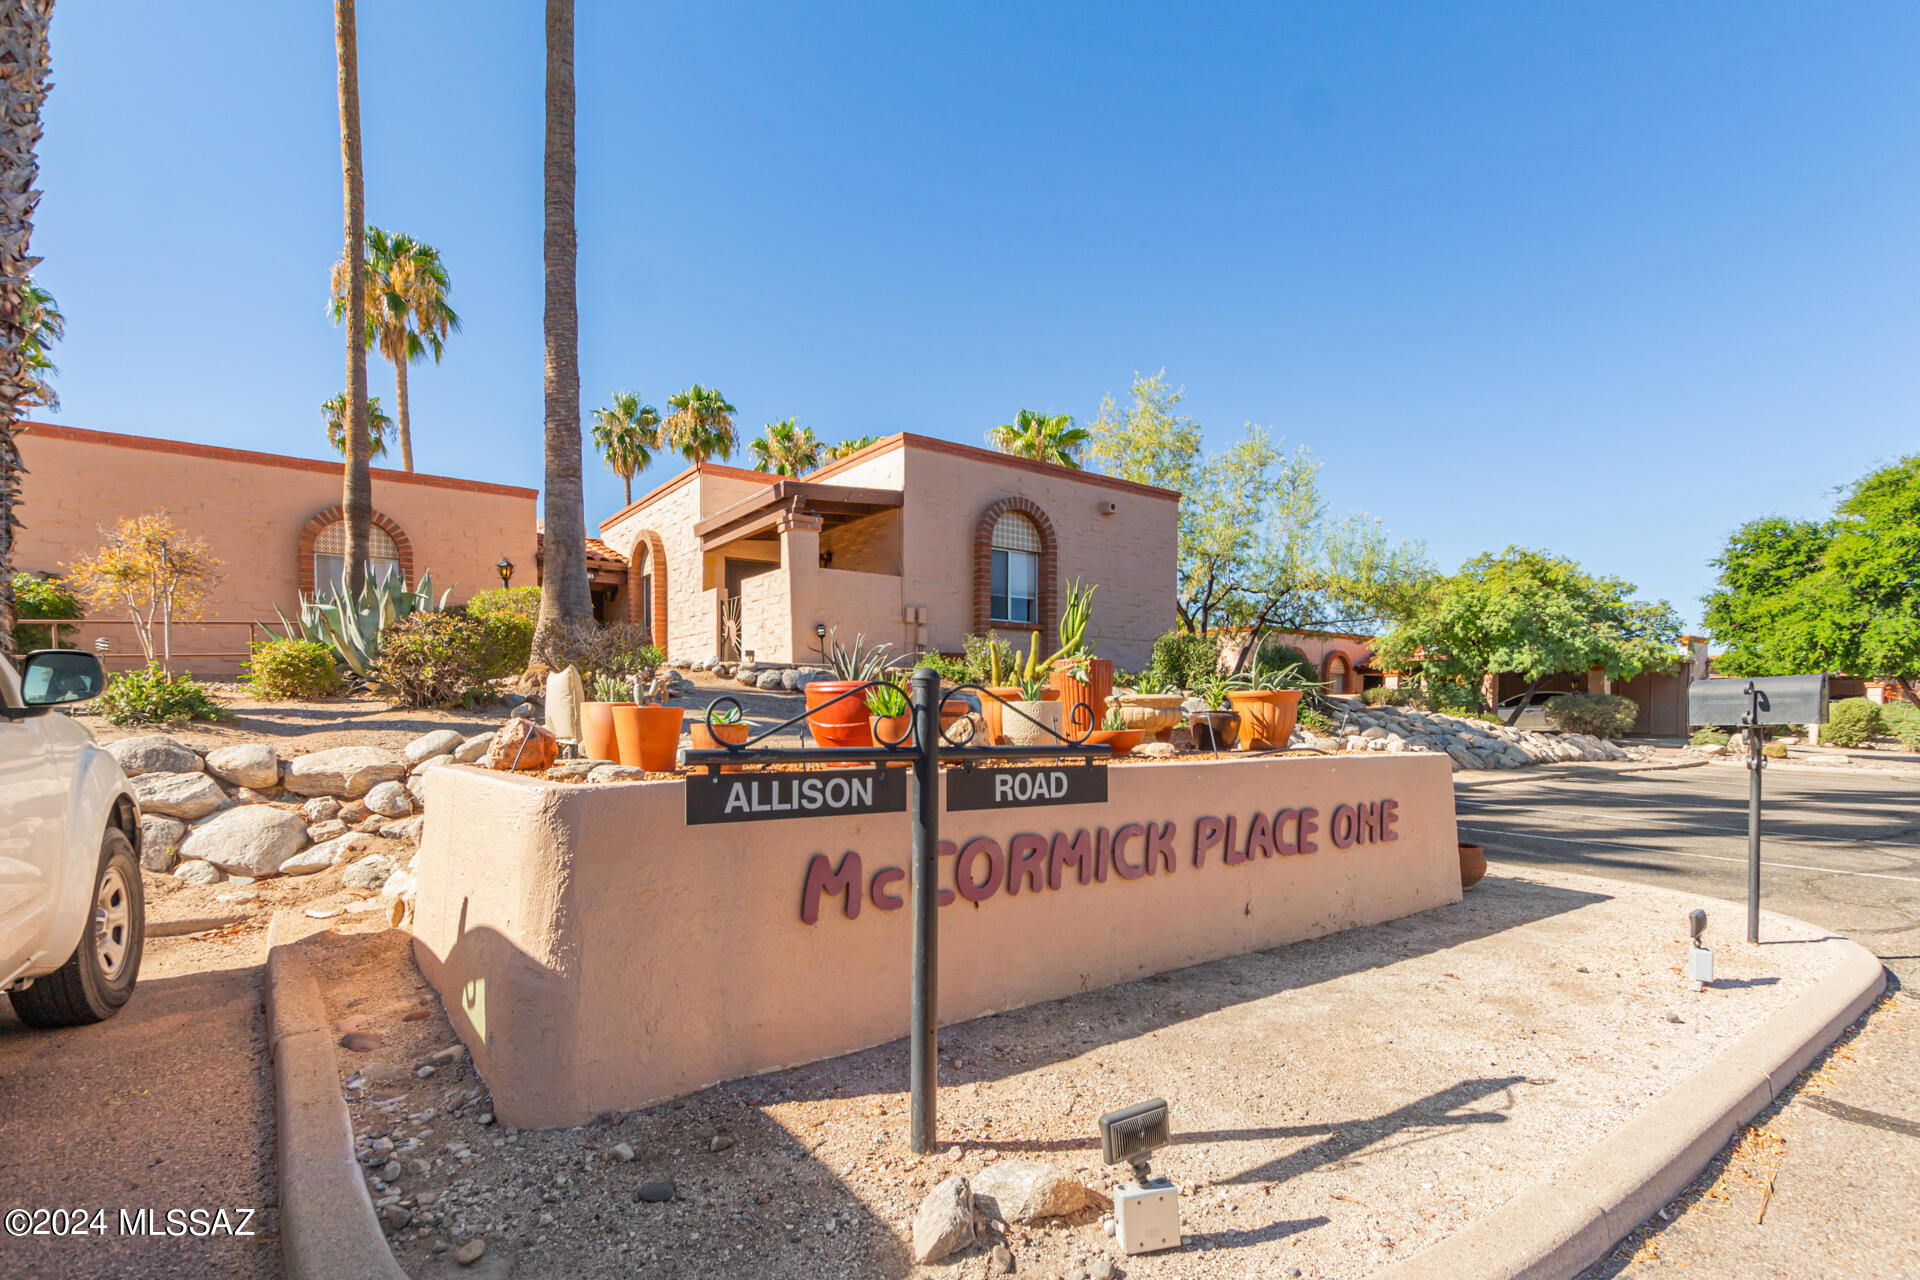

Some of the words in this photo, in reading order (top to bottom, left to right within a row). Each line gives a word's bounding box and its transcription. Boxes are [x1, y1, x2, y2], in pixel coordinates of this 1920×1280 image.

[724, 777, 873, 814] ALLISON
[994, 771, 1068, 802] ROAD
[1193, 807, 1319, 869] PLACE
[1331, 799, 1399, 849] ONE
